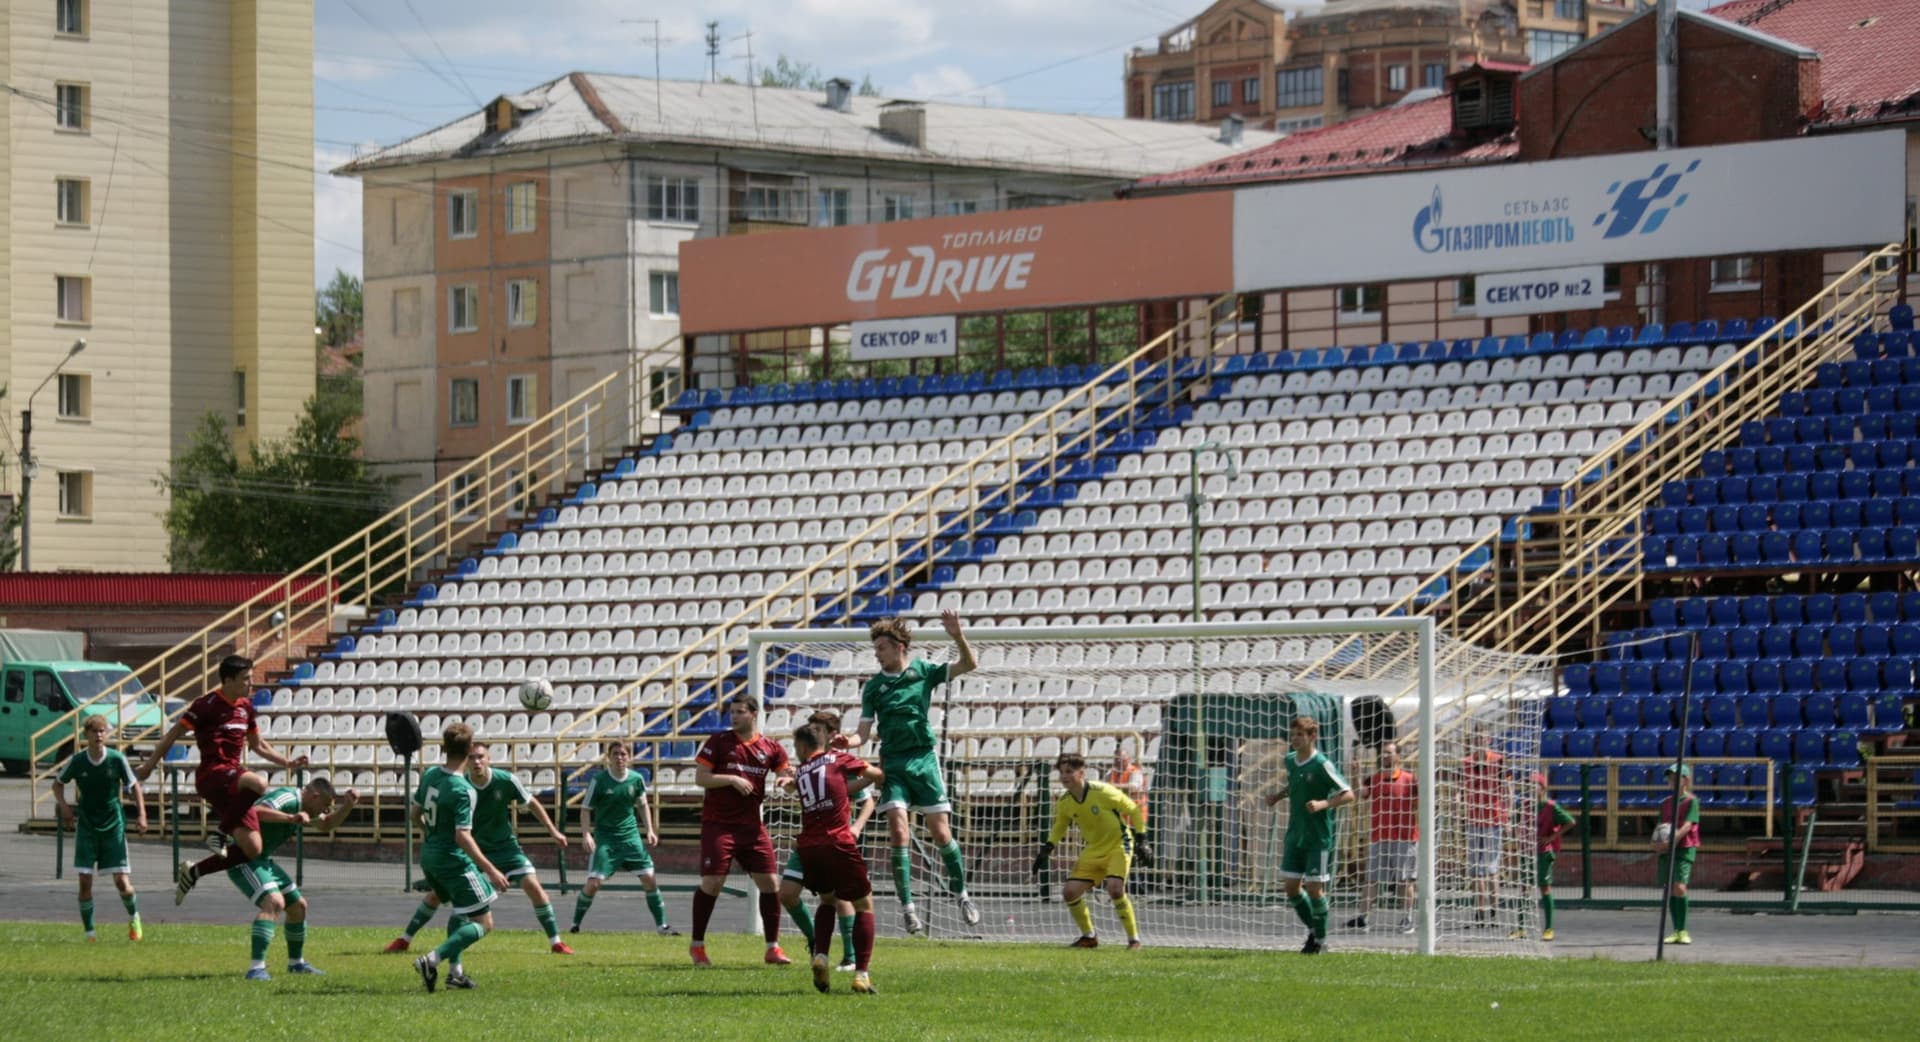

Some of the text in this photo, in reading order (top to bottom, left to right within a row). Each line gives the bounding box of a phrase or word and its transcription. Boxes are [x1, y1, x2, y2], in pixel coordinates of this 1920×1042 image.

[1504, 197, 1569, 216] СЕТЬ АЗС
[942, 225, 1043, 249] ТОПЛИВО
[1445, 216, 1575, 252] ГАЗПРОМНЕФТЬ
[1486, 279, 1592, 303] СЕКТОР №2
[860, 328, 948, 348] СЕКТОР №1
[798, 765, 826, 808] 97
[424, 786, 440, 827] 5
